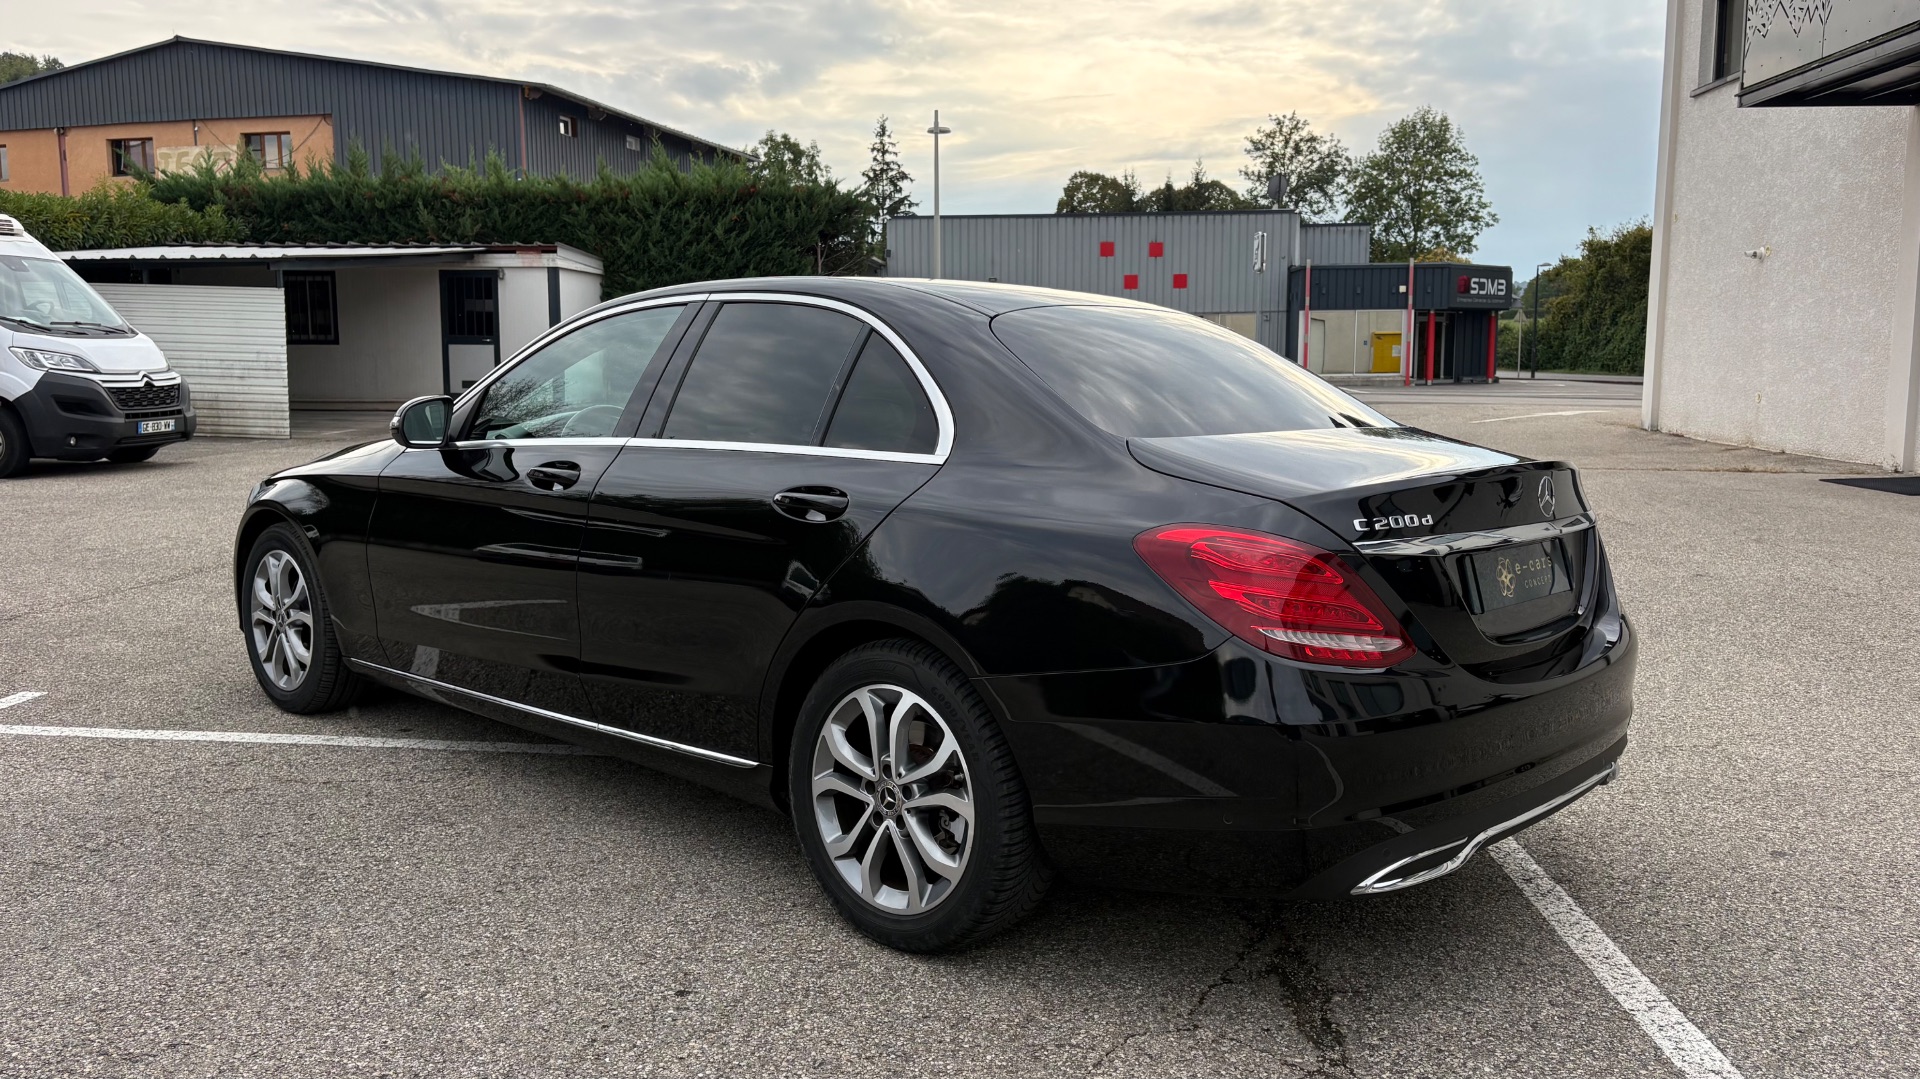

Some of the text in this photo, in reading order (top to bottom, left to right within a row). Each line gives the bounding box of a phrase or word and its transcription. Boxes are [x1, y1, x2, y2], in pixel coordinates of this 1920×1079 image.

[1470, 277, 1506, 296] SDMB
[1353, 518, 1371, 531] C
[1515, 556, 1552, 575] e-cars
